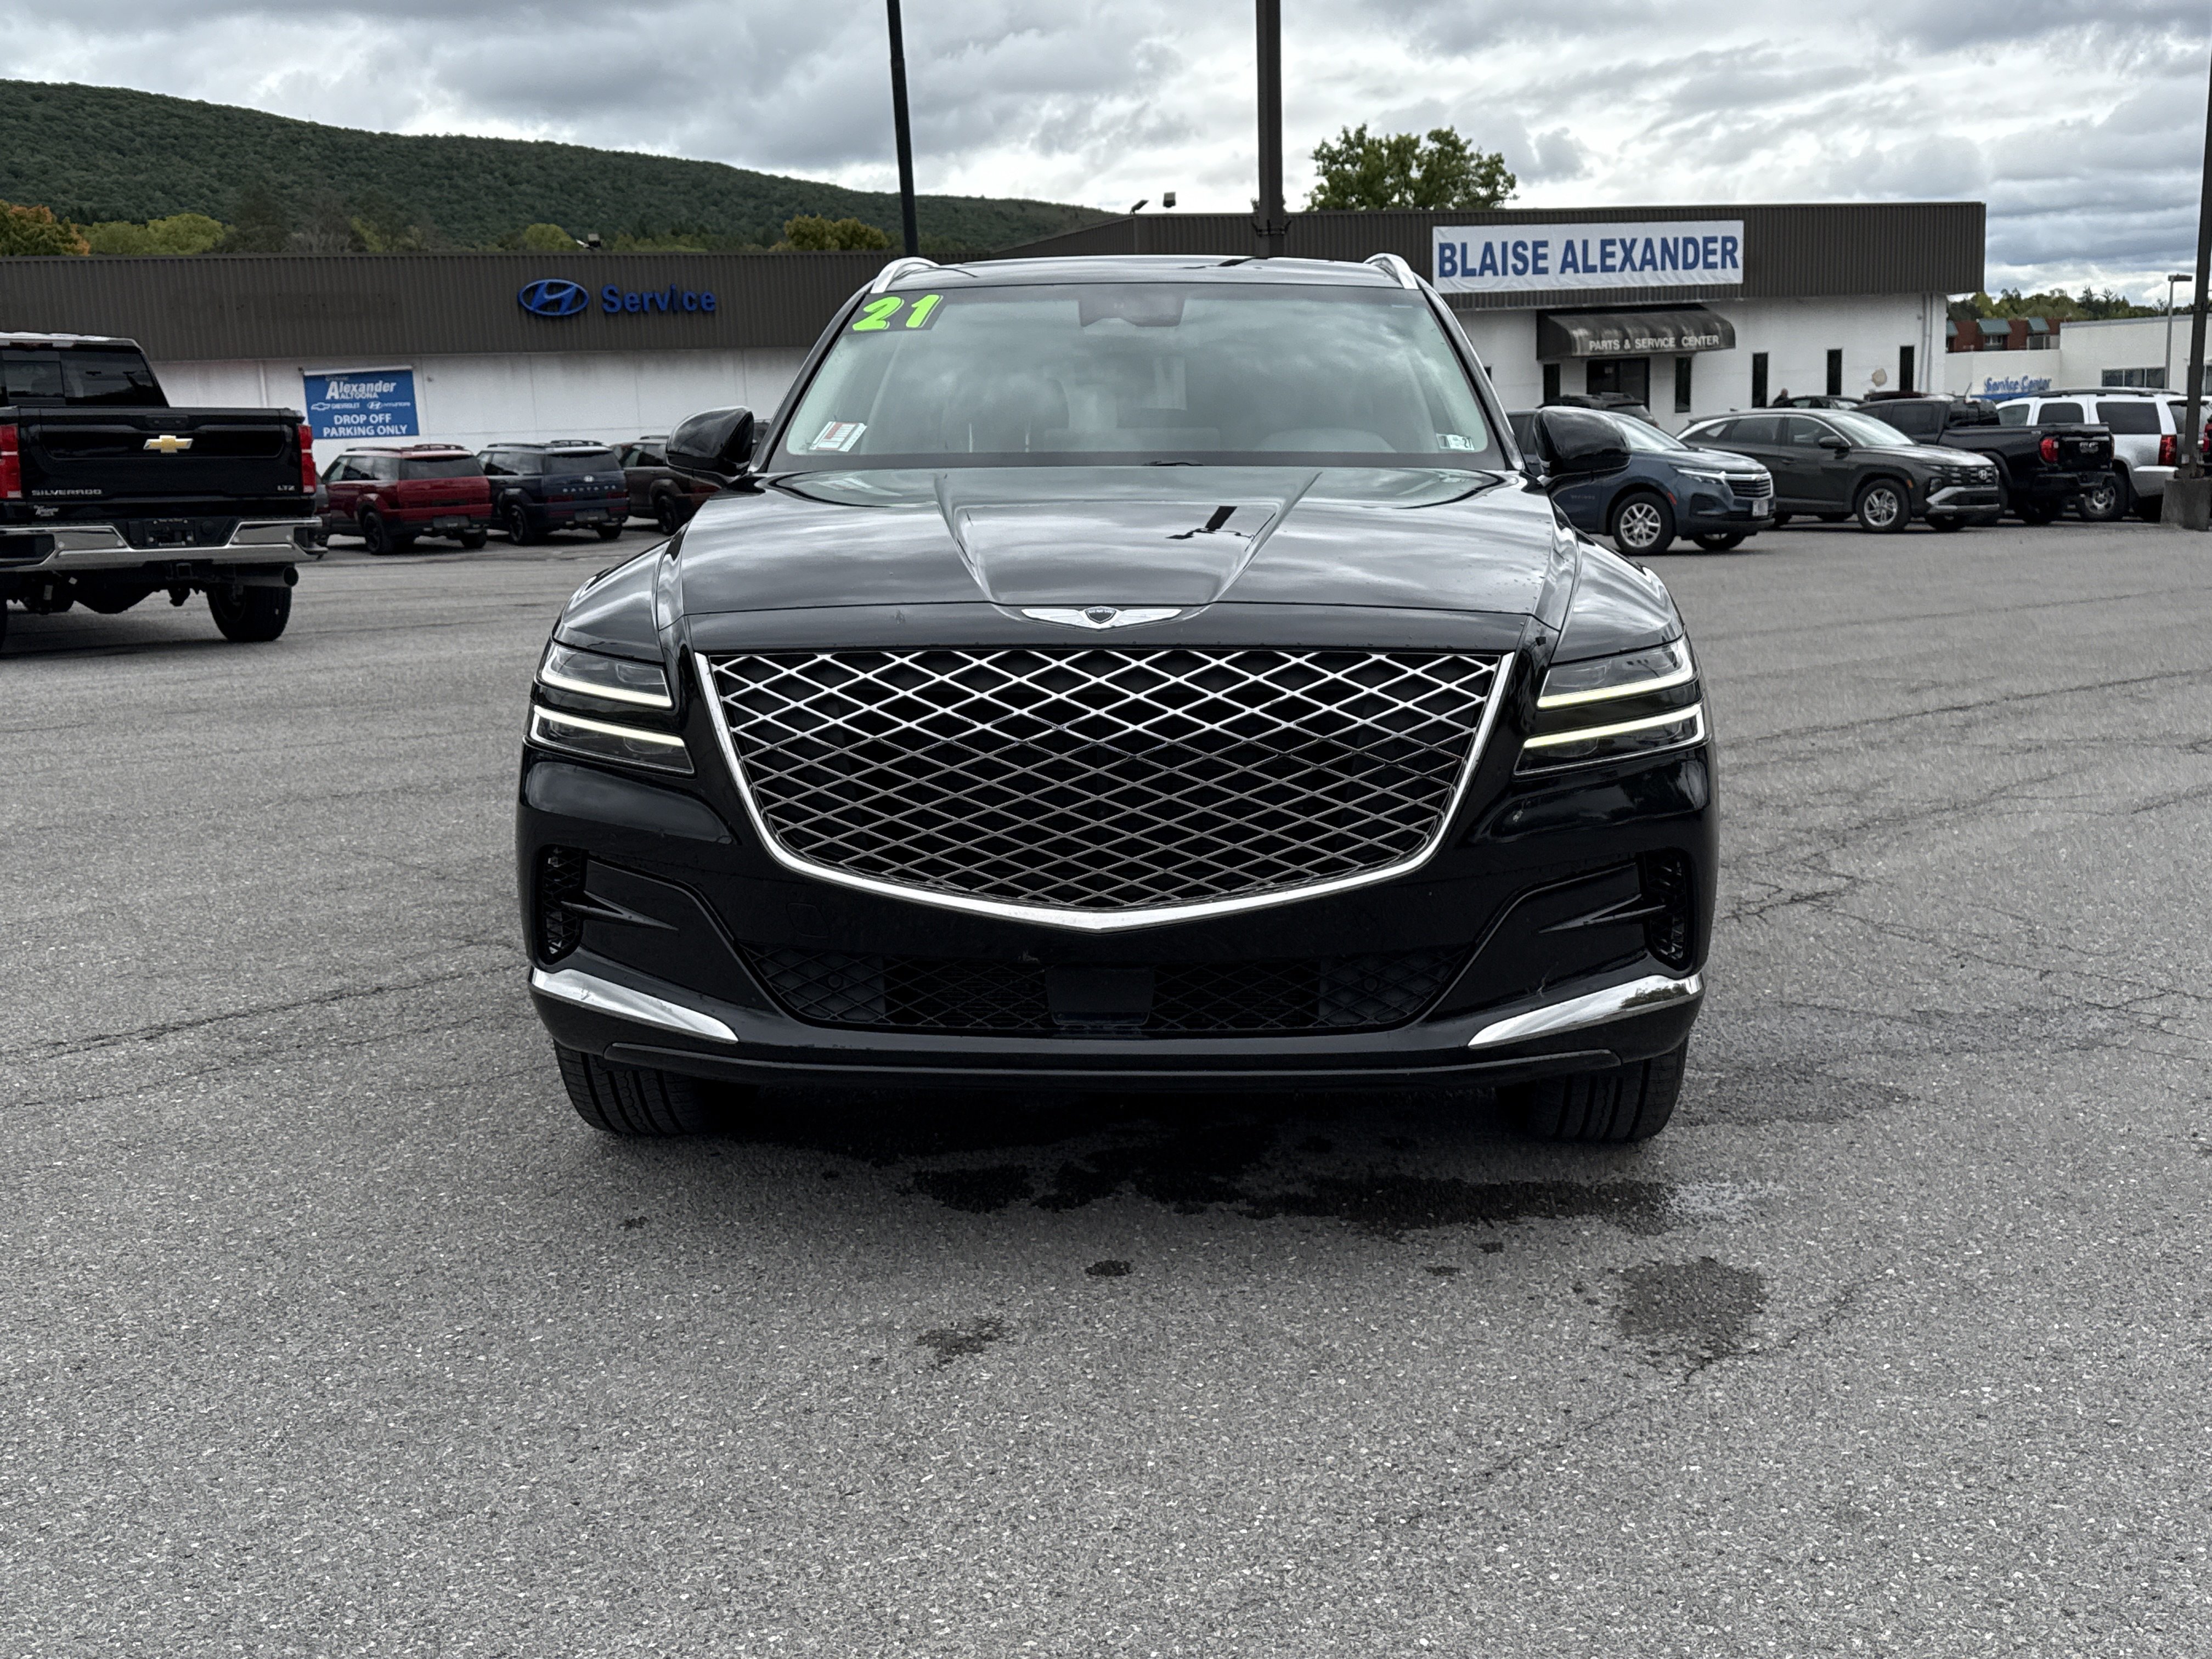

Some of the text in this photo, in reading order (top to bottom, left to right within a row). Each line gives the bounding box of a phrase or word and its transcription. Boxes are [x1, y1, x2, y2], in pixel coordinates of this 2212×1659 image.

[1439, 235, 1739, 277] BLAISE ALEXANDER
[601, 283, 716, 312] Service
[852, 295, 944, 331] 21
[1589, 335, 1719, 351] PARTS & SERVICE CENTER
[325, 380, 397, 399] Alexander
[1984, 375, 2052, 391] Service Center
[334, 413, 392, 425] DROP OFF
[323, 425, 408, 437] PARKING ONLY
